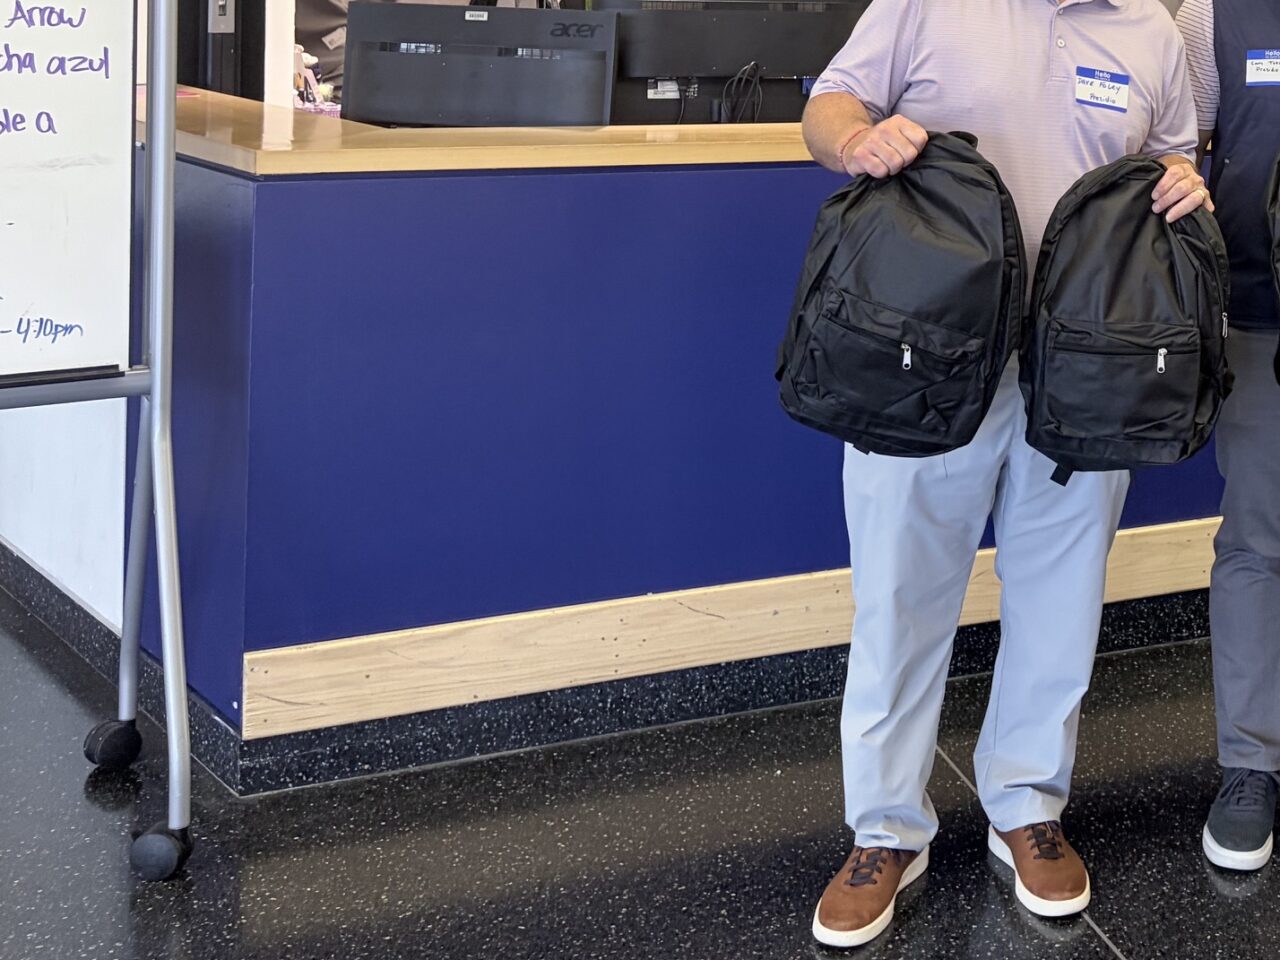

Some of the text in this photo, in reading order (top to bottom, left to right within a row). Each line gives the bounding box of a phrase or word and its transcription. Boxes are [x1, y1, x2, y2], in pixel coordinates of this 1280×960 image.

[4, 0, 87, 29] Arrow
[550, 22, 603, 38] acer
[46, 46, 110, 79] azul
